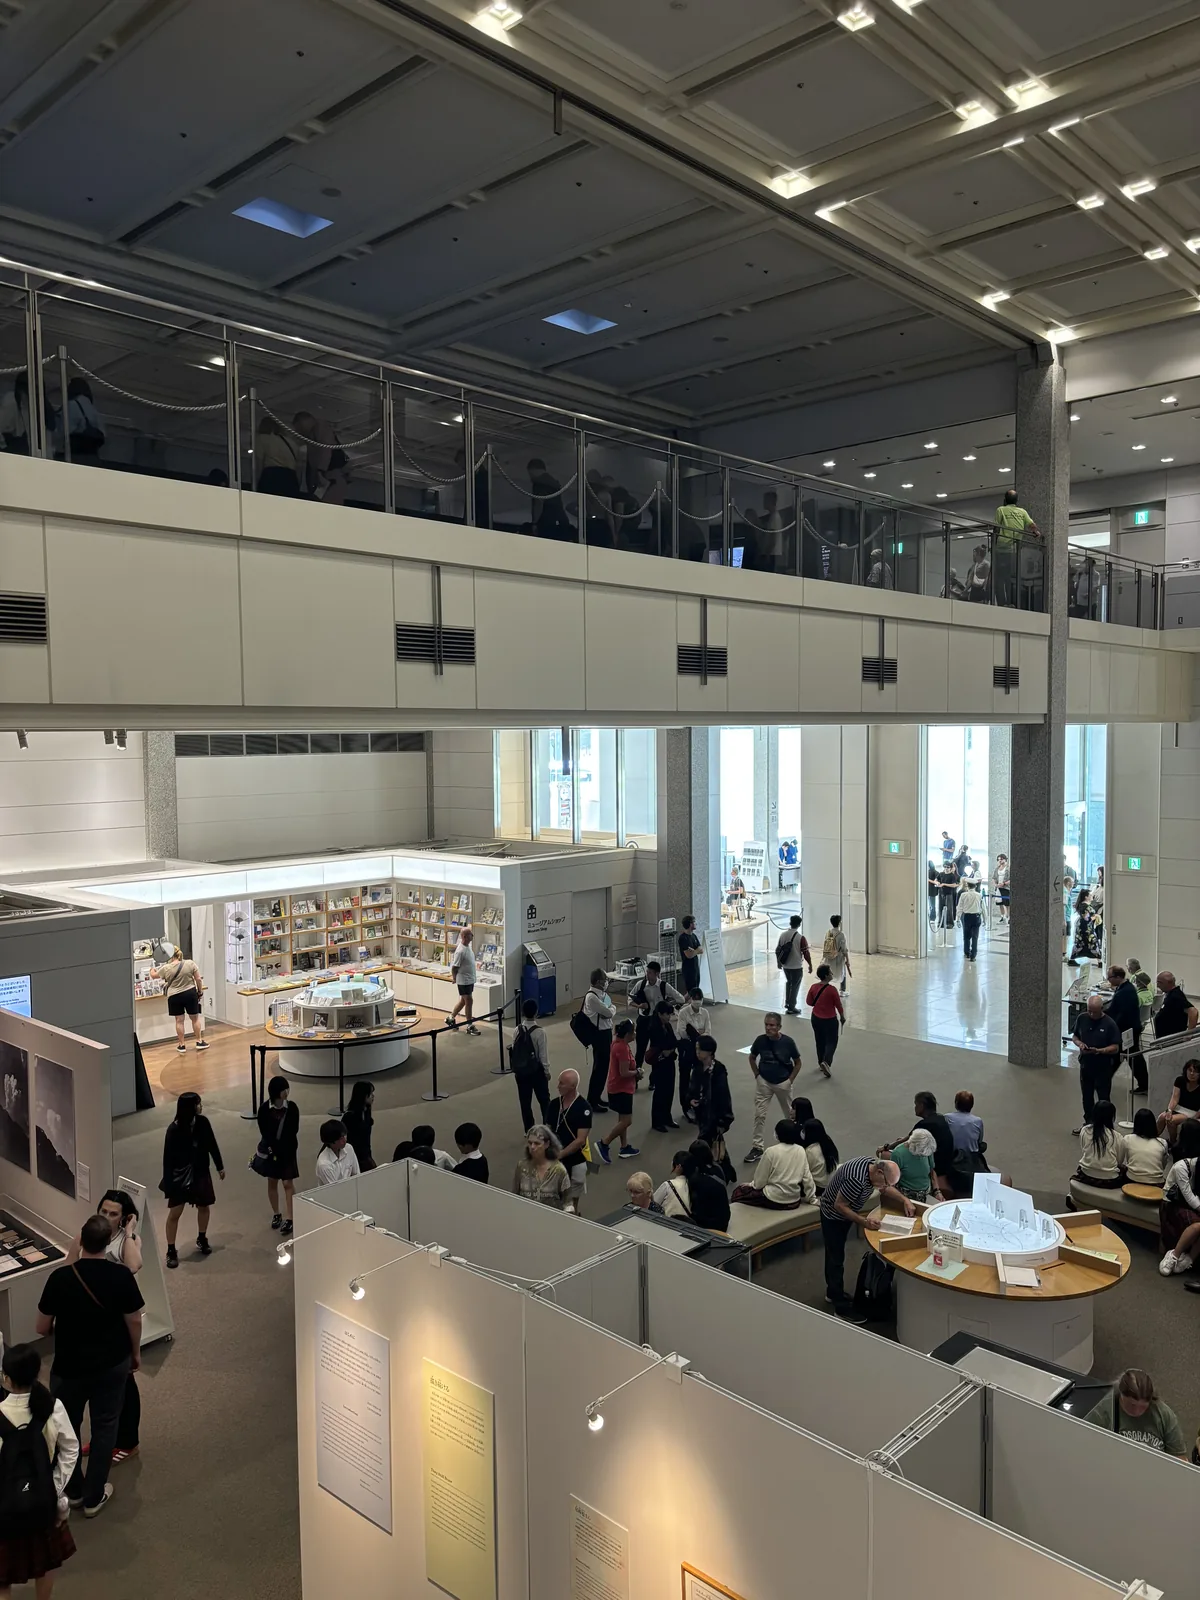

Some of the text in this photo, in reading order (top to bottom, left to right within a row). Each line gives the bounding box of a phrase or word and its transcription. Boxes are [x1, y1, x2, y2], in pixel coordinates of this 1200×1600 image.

[528, 916, 566, 928] ミュージアムショップ
